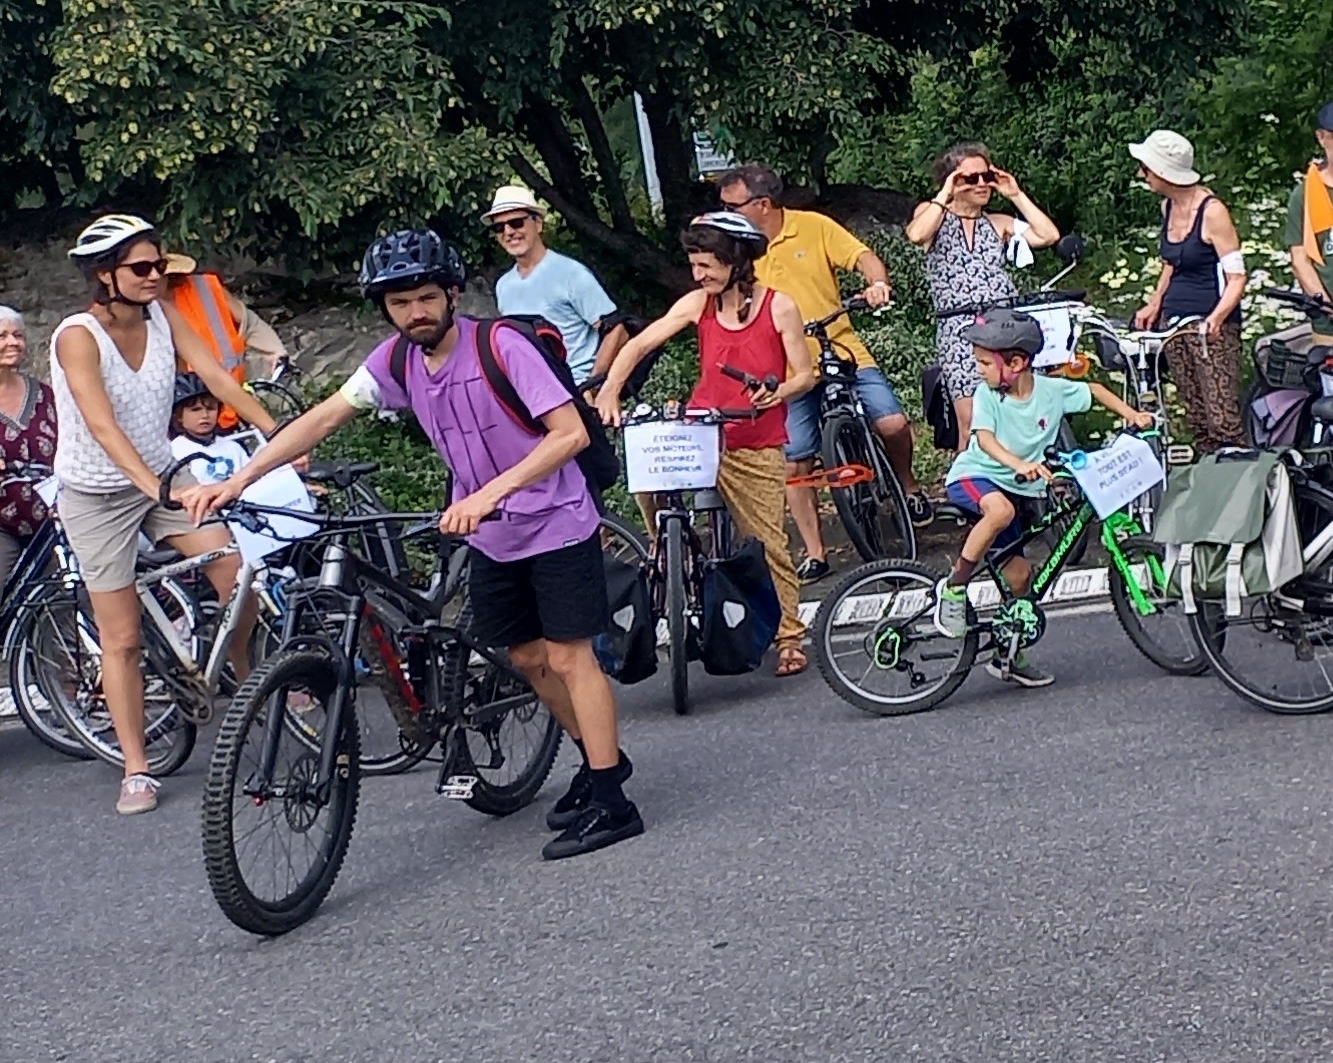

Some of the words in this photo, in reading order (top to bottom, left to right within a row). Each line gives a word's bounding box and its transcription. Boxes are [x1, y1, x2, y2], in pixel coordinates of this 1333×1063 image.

[641, 445, 661, 454] VOS
[1097, 458, 1118, 476] TOUT
[1117, 450, 1133, 464] EST
[648, 466, 659, 474] LE
[1099, 473, 1118, 490] PLUS
